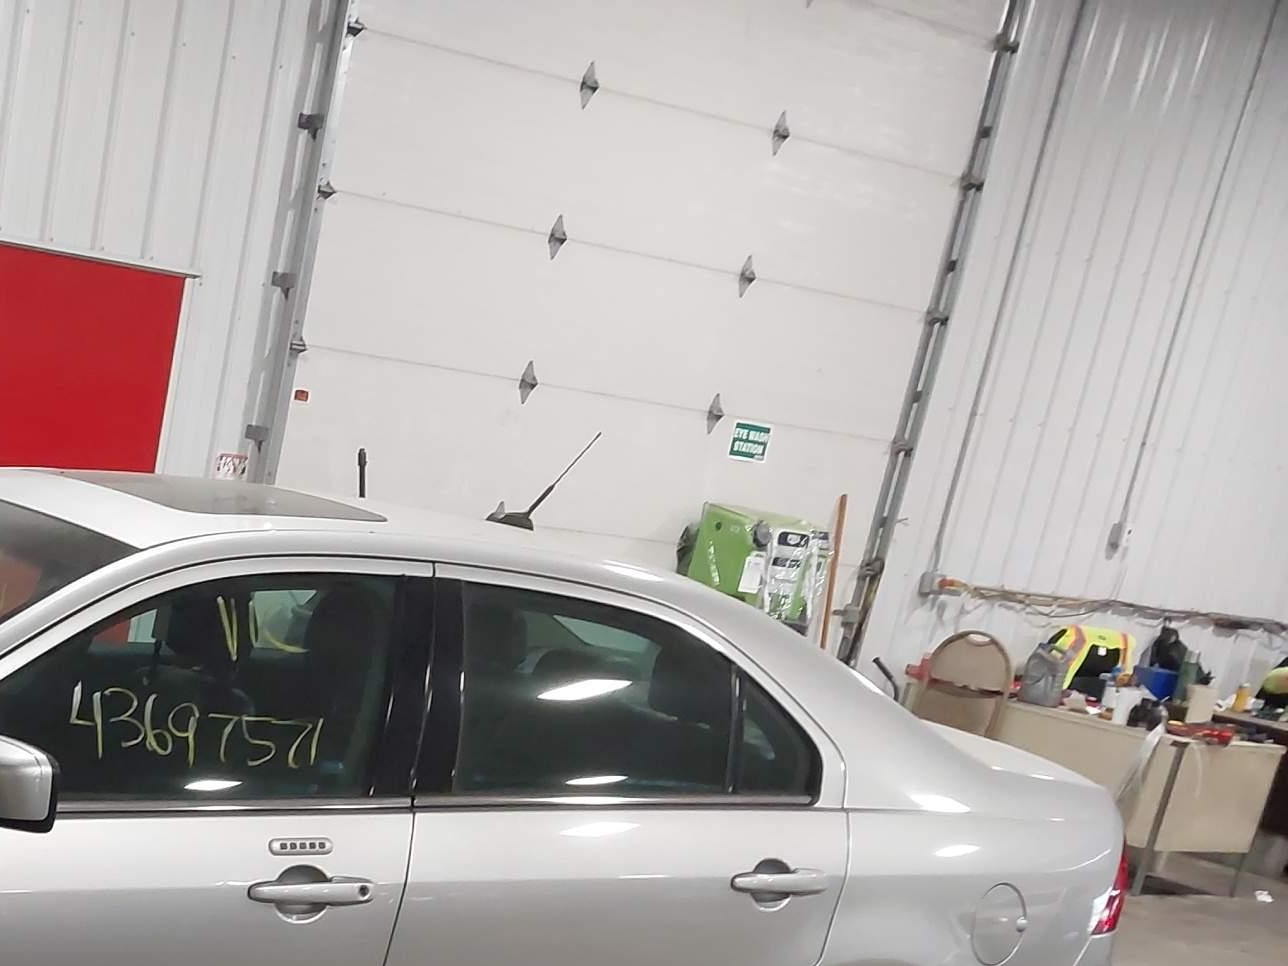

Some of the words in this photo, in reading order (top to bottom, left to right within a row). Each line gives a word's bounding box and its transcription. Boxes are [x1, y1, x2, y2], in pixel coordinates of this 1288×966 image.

[734, 427, 749, 440] EYE
[732, 440, 764, 455] STATION
[69, 680, 325, 769] 43697571
